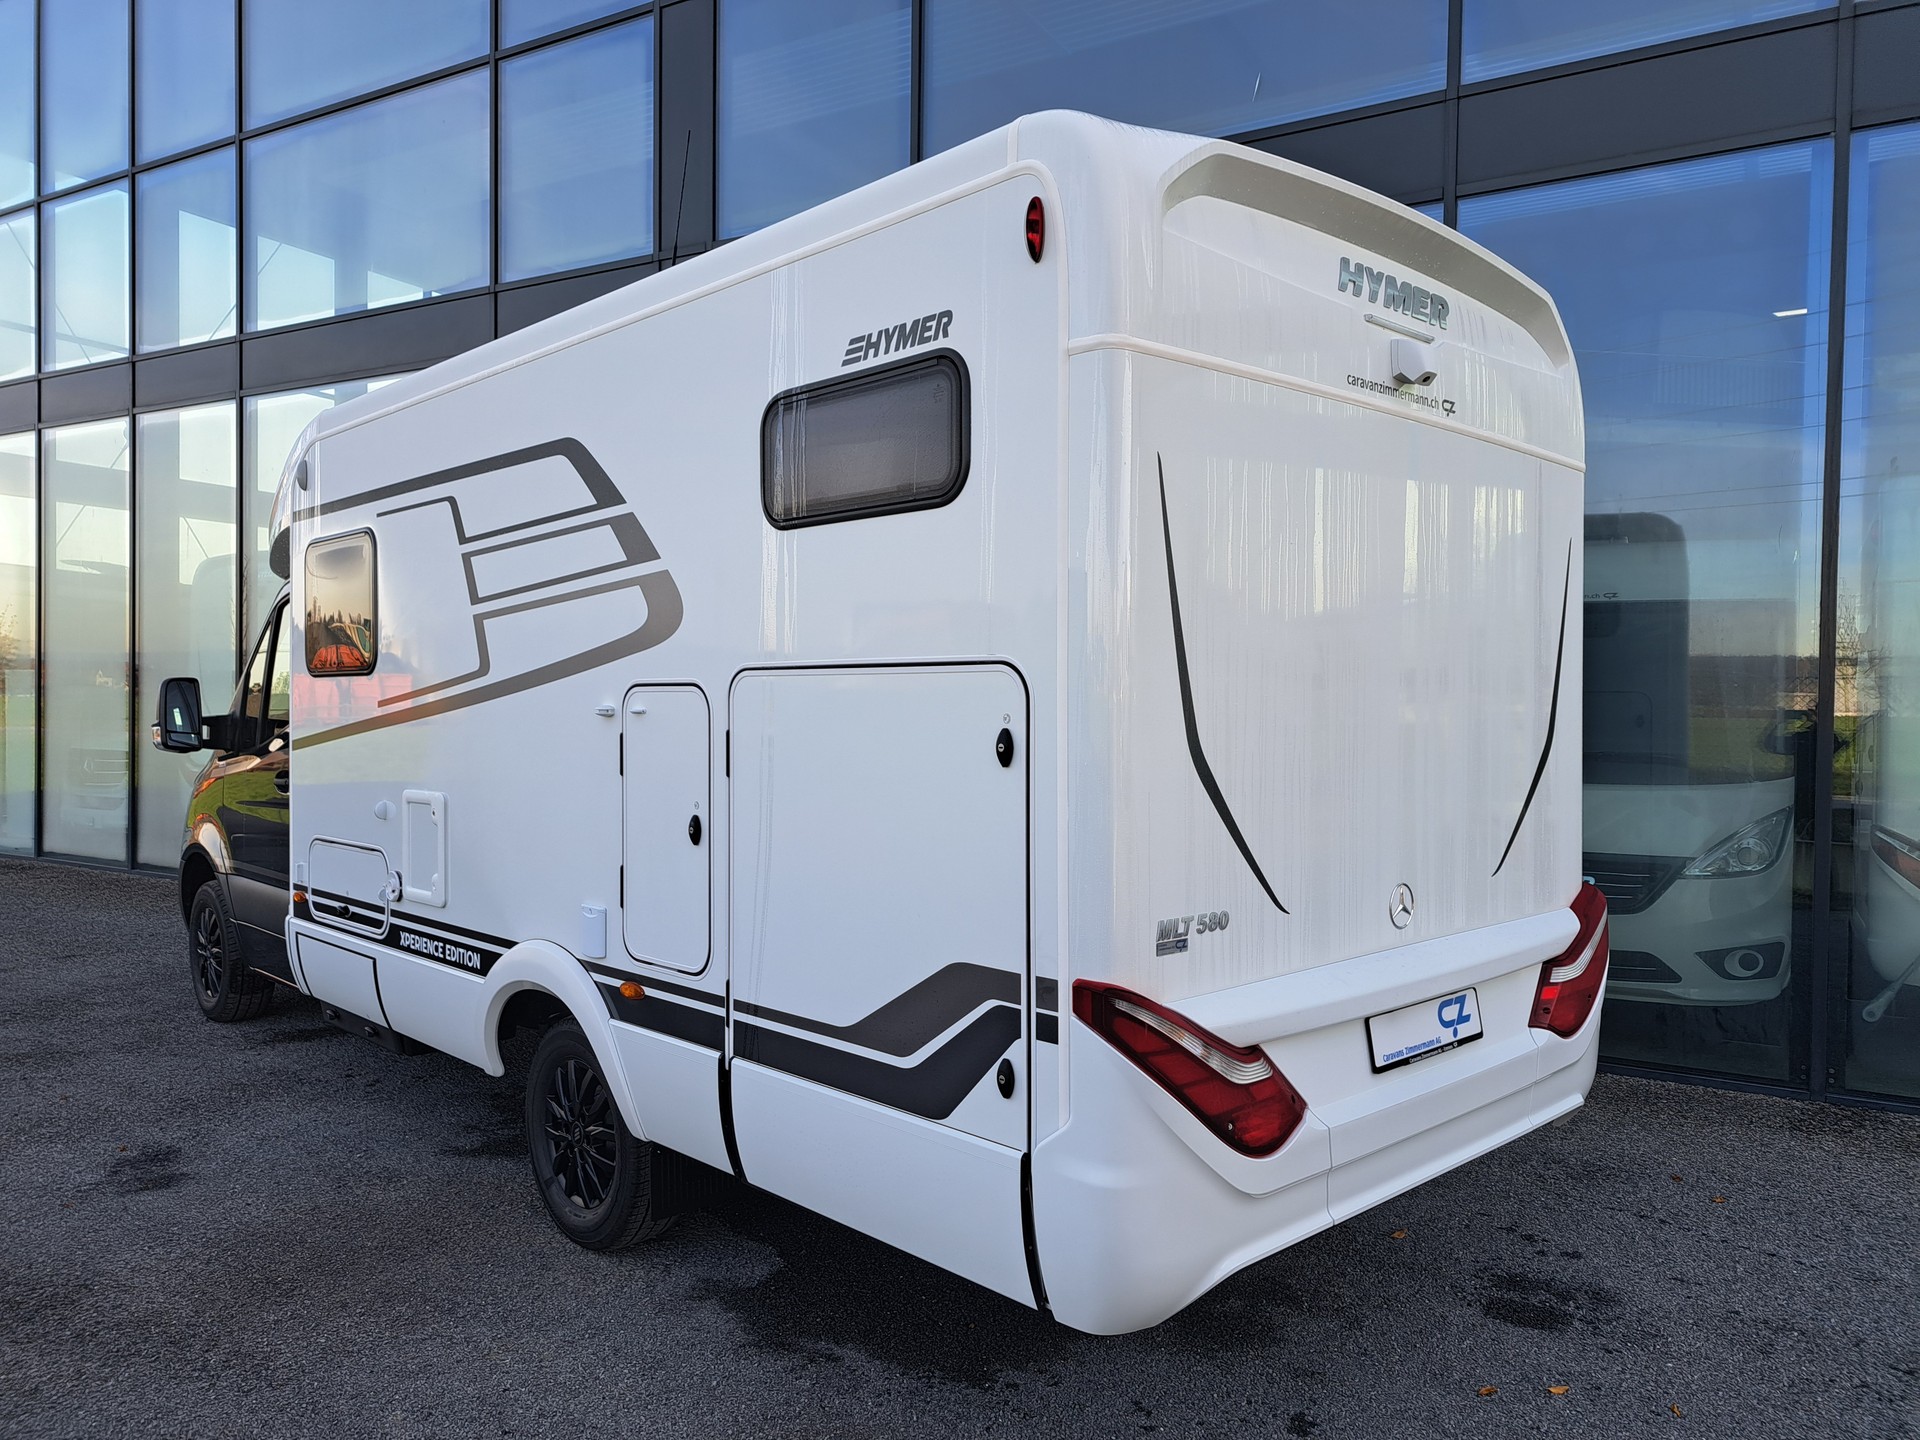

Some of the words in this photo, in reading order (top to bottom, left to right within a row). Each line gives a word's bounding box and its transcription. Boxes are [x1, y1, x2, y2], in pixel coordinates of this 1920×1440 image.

[1338, 256, 1450, 331] HYMER
[862, 309, 954, 362] HYMER
[1346, 373, 1440, 411] caravanzimmermann.ch
[1156, 915, 1195, 942] MLT
[1195, 910, 1230, 934] 580
[399, 930, 444, 958] XPERIENCE
[445, 944, 480, 969] EDITION
[1437, 993, 1472, 1029] CZ
[1382, 1048, 1405, 1063] Caravans
[1404, 1038, 1436, 1056] Zimmermann
[1435, 1036, 1442, 1046] AG
